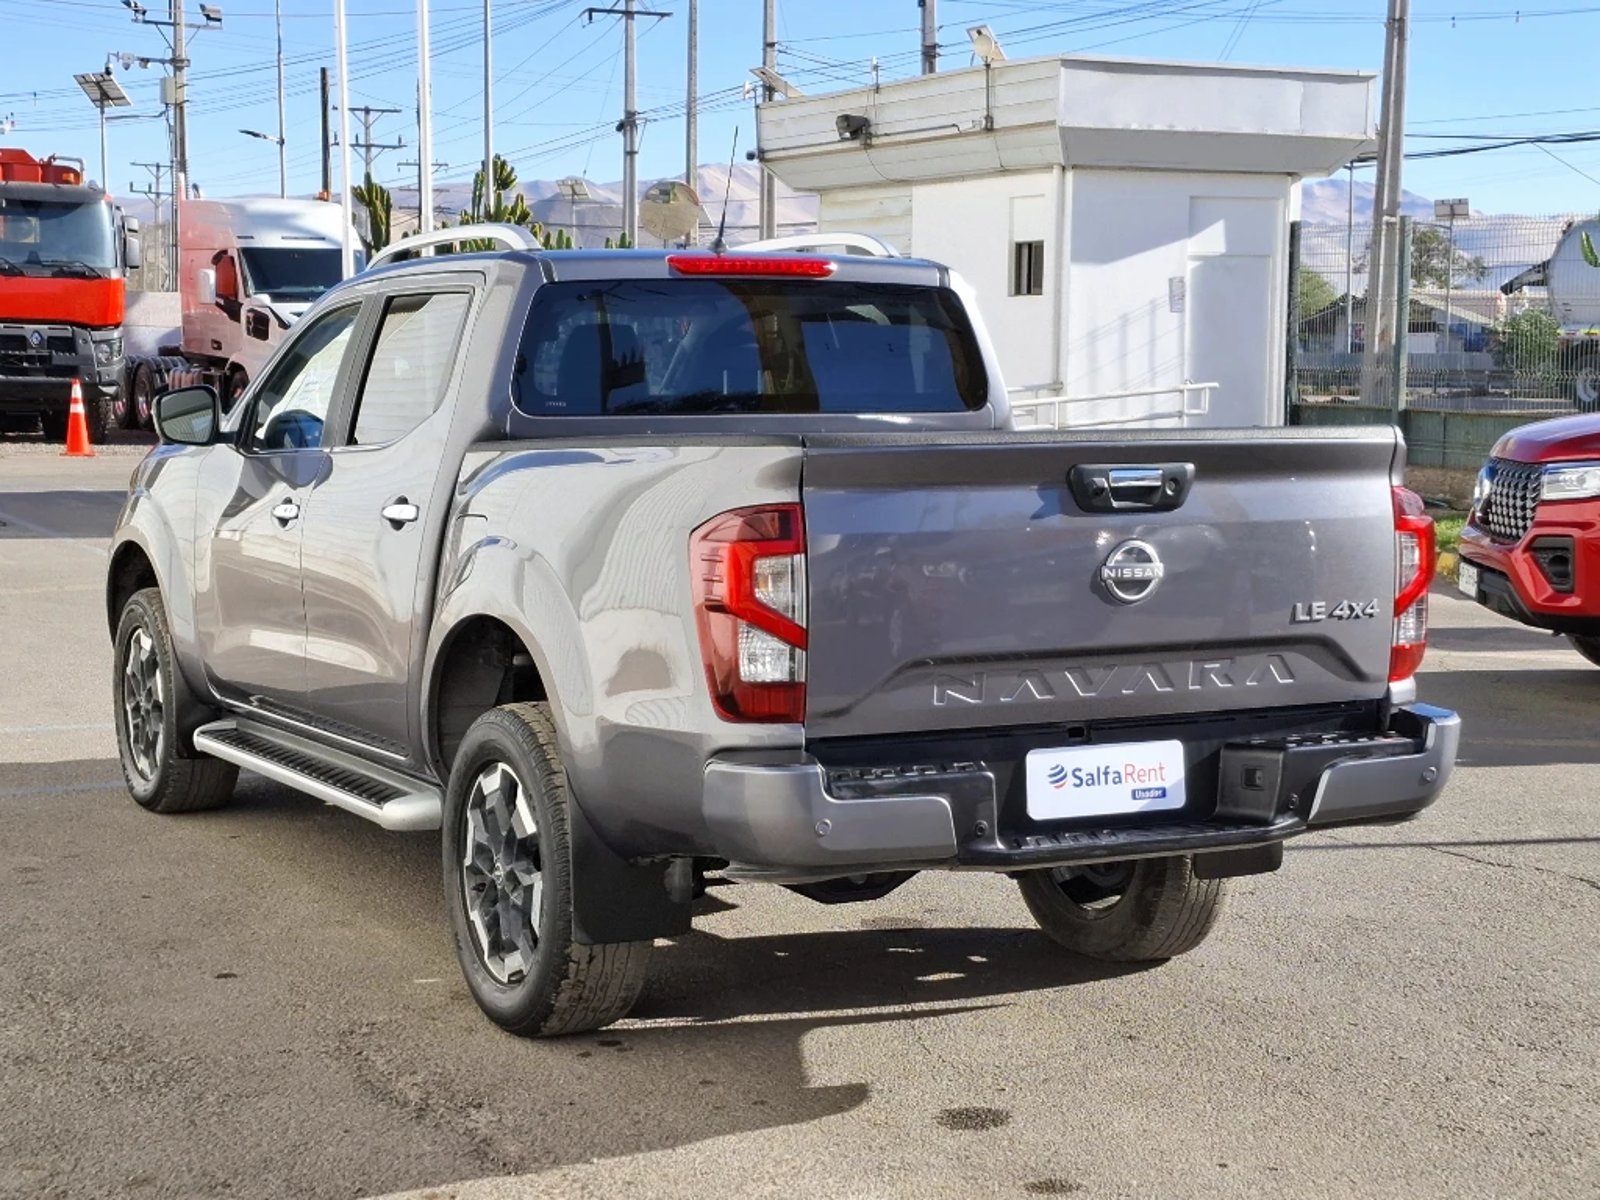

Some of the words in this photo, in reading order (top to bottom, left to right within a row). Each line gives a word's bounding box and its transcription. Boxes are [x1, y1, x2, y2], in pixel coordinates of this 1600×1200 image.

[1103, 567, 1163, 578] NISSAN
[1294, 601, 1326, 621] LE
[933, 654, 1295, 706] NAVARA
[1071, 761, 1166, 788] SalfaRent
